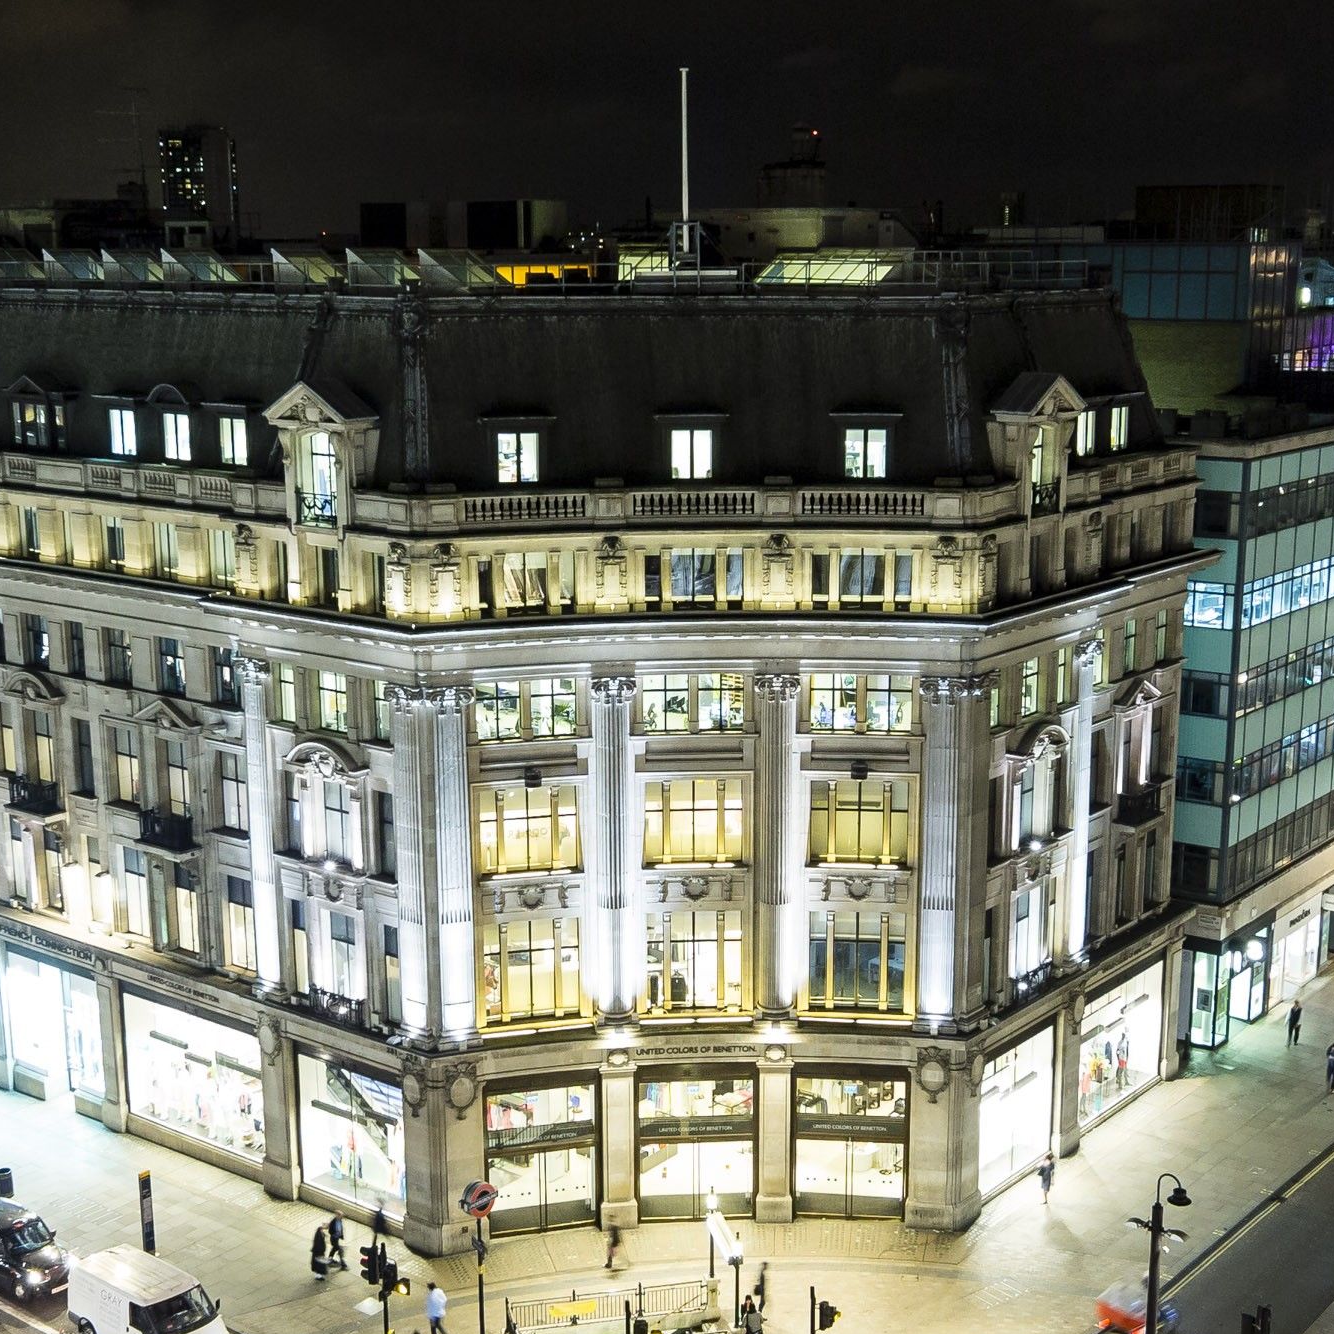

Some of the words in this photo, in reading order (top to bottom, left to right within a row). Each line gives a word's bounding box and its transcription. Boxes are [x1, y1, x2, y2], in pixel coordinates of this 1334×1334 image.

[0, 925, 33, 943] FRENCH
[35, 935, 93, 963] CONNECTION
[636, 1047, 666, 1056] UNITED
[667, 1046, 699, 1055] COLORS
[100, 1289, 123, 1307] GRAY
